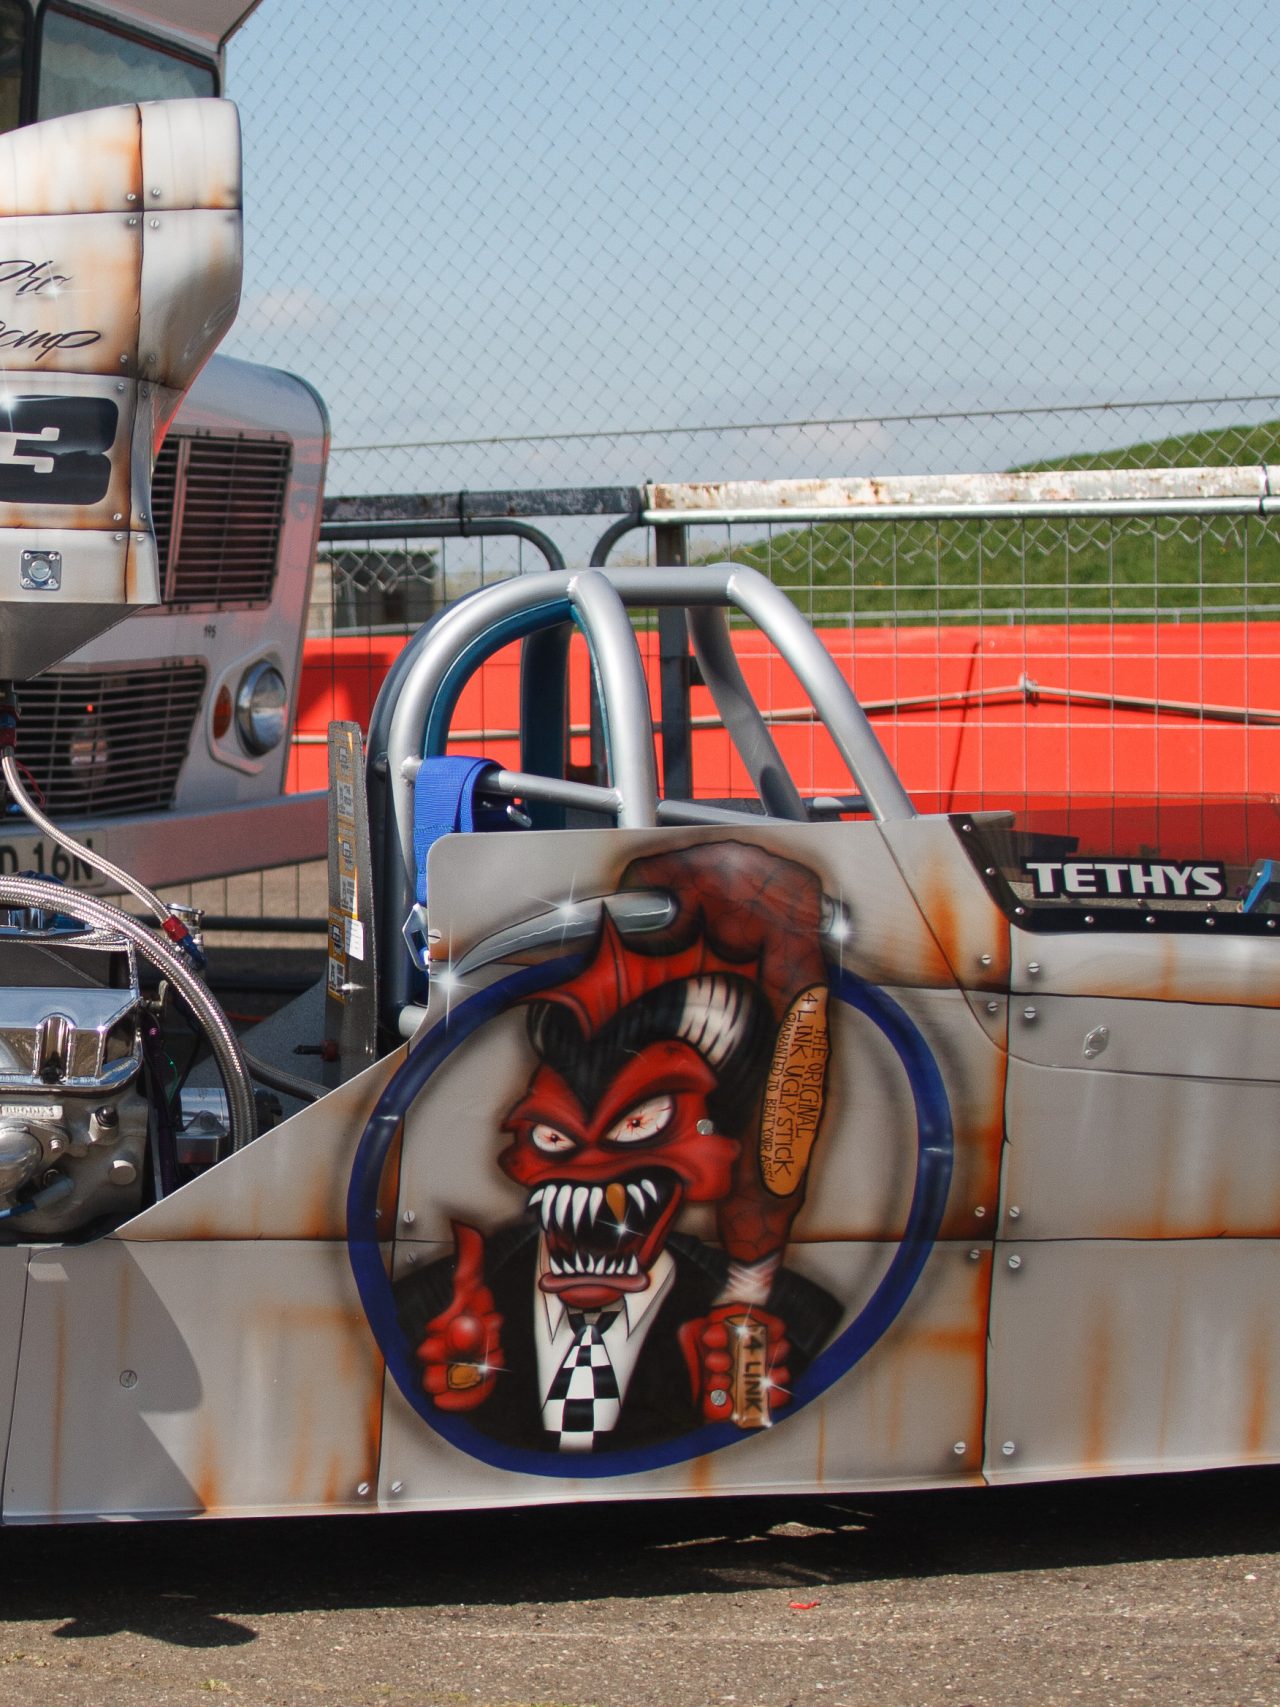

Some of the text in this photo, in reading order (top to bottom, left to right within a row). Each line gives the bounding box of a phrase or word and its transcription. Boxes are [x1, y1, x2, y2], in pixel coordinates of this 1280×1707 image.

[1026, 862, 1223, 897] TETHYS
[767, 1079, 780, 1092] TO
[773, 991, 818, 1176] 4 LINK UGLY STICK
[795, 1028, 828, 1138] THE ORIGINAL
[763, 1098, 777, 1125] BEAT
[761, 1126, 774, 1152] YOUR
[744, 1361, 763, 1413] LINK
